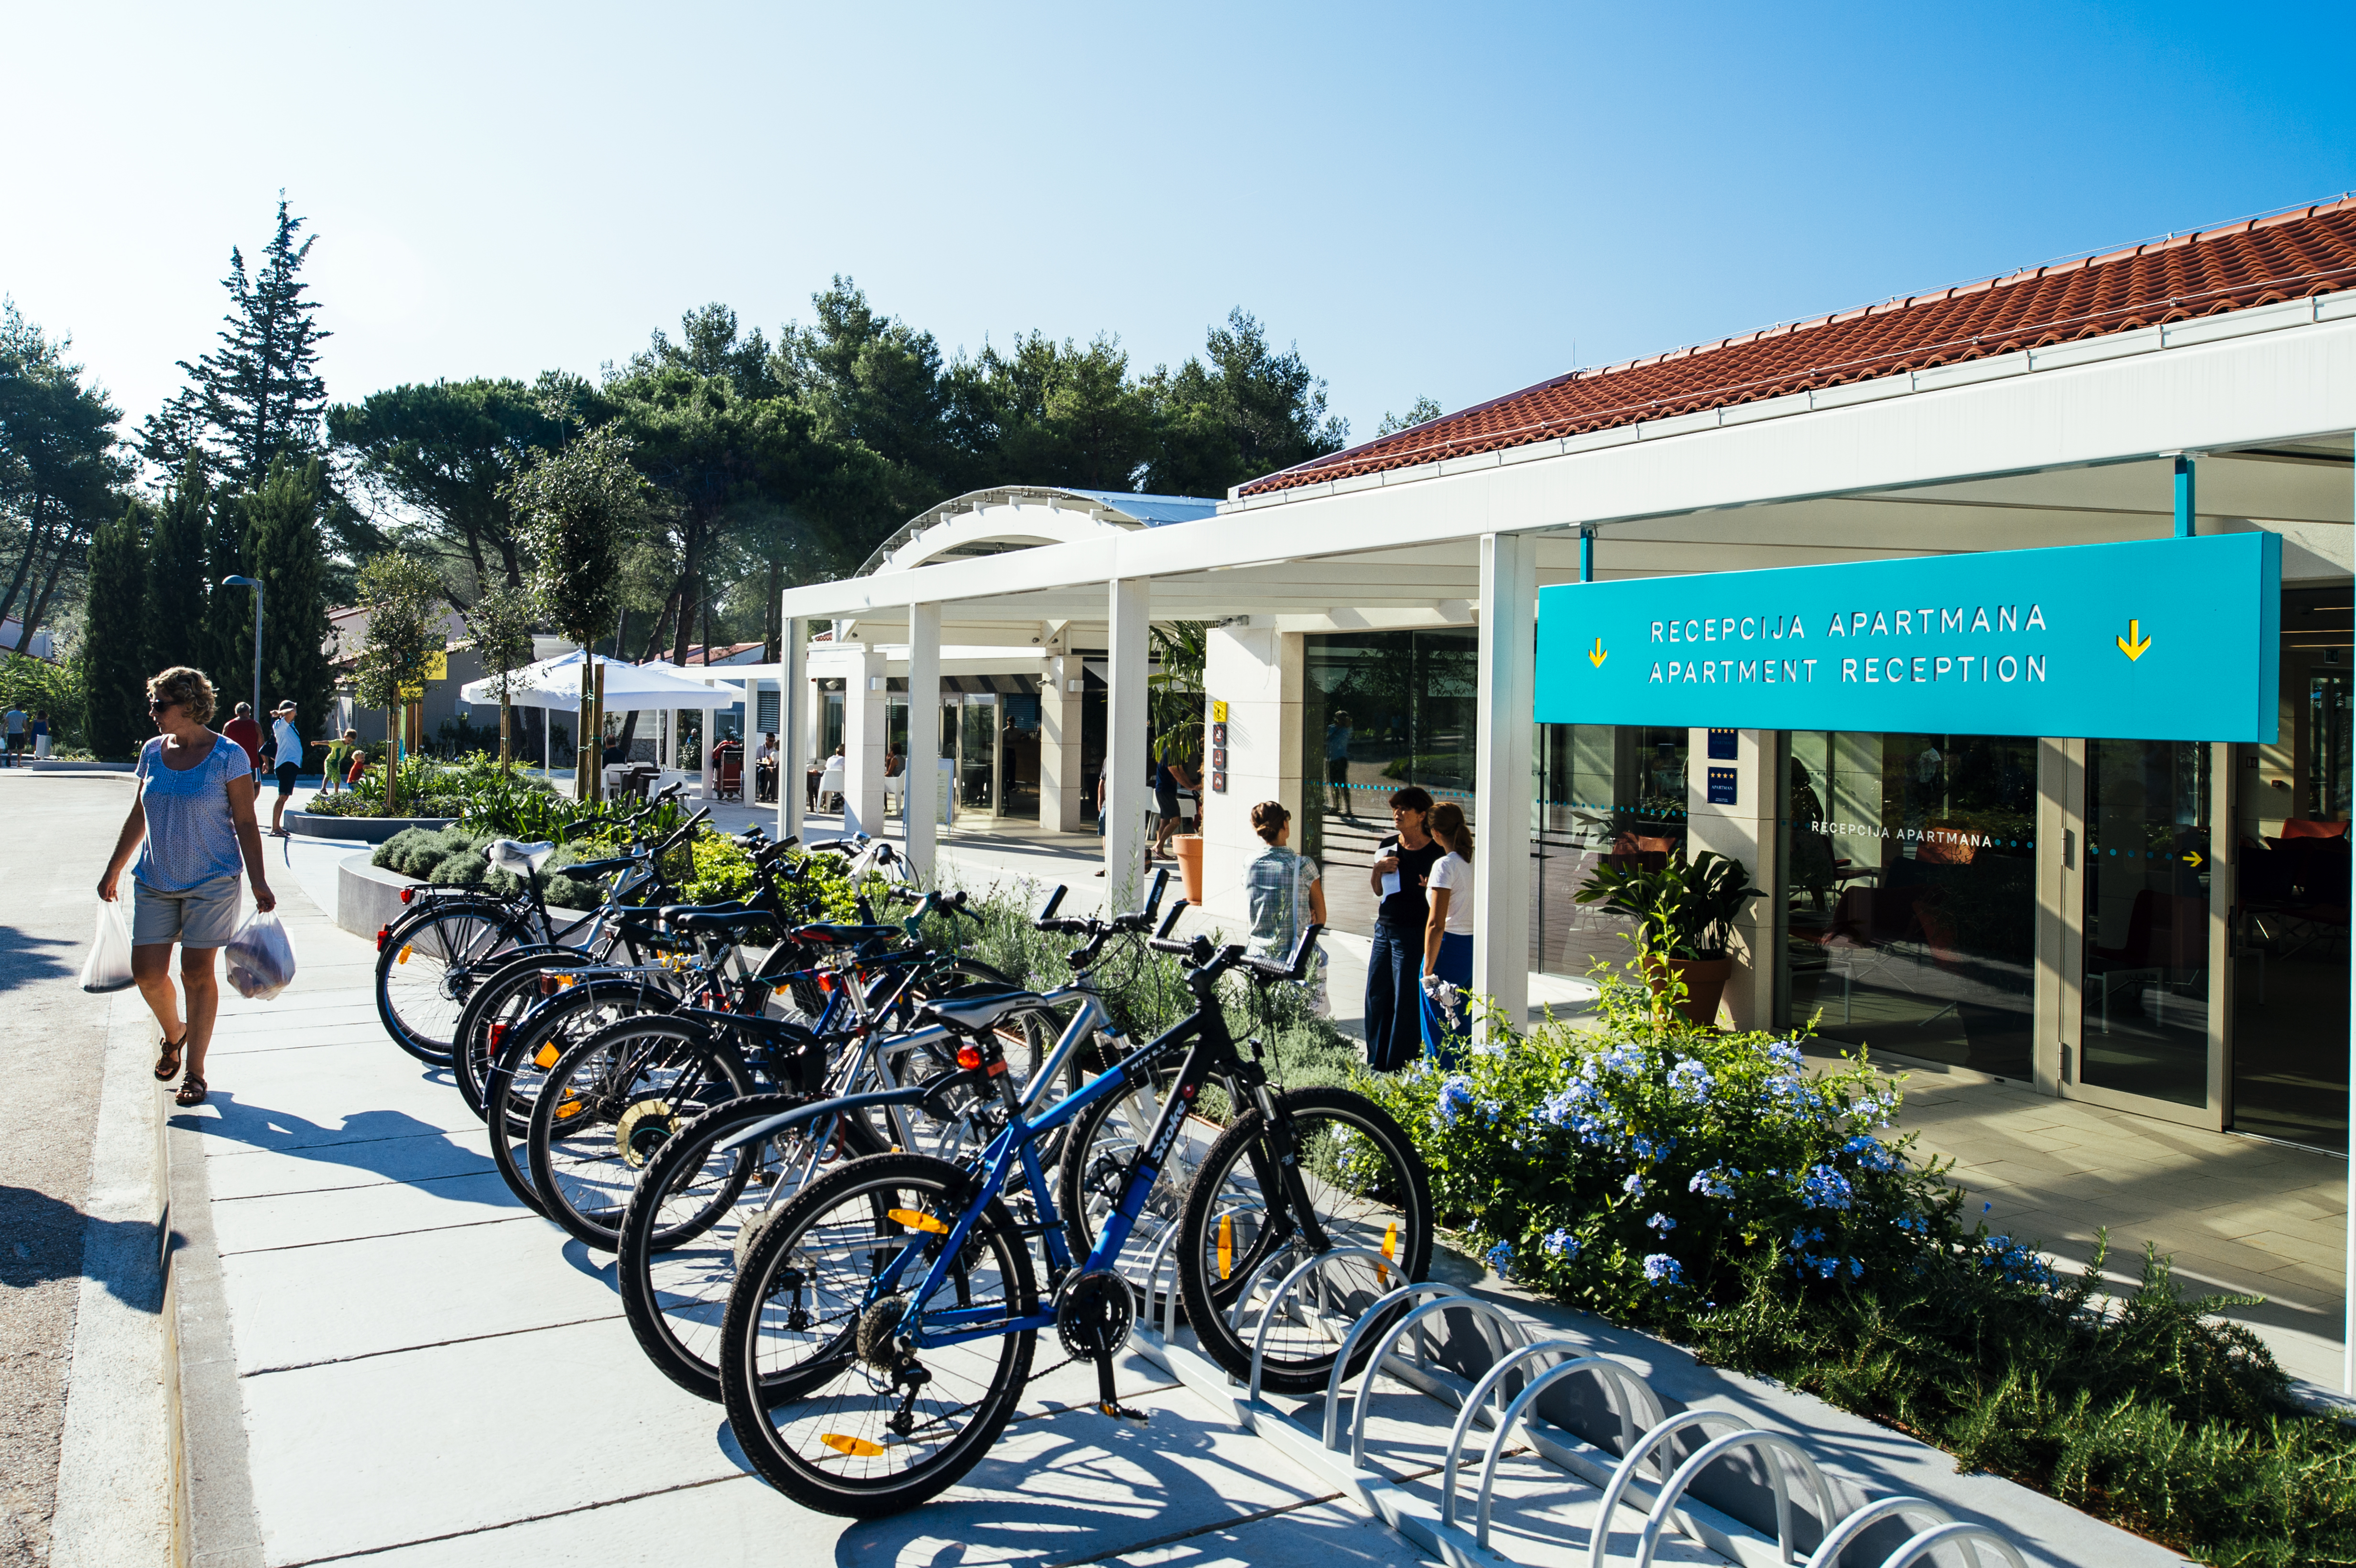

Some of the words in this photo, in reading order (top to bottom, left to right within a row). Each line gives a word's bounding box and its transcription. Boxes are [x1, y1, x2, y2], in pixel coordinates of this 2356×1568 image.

[1650, 615, 1805, 643] RECEPCIJA
[1827, 604, 2047, 637] APARTMANA
[1648, 658, 1818, 684] APARTMENT
[1842, 655, 2046, 683] RECEPTION
[1812, 821, 1889, 838] RECEPCIJA
[1897, 828, 1992, 848] APARTMANA
[827, 996, 849, 1031] EGA
[1130, 1054, 1151, 1071] MTX
[1150, 1100, 1187, 1164] Stoke
